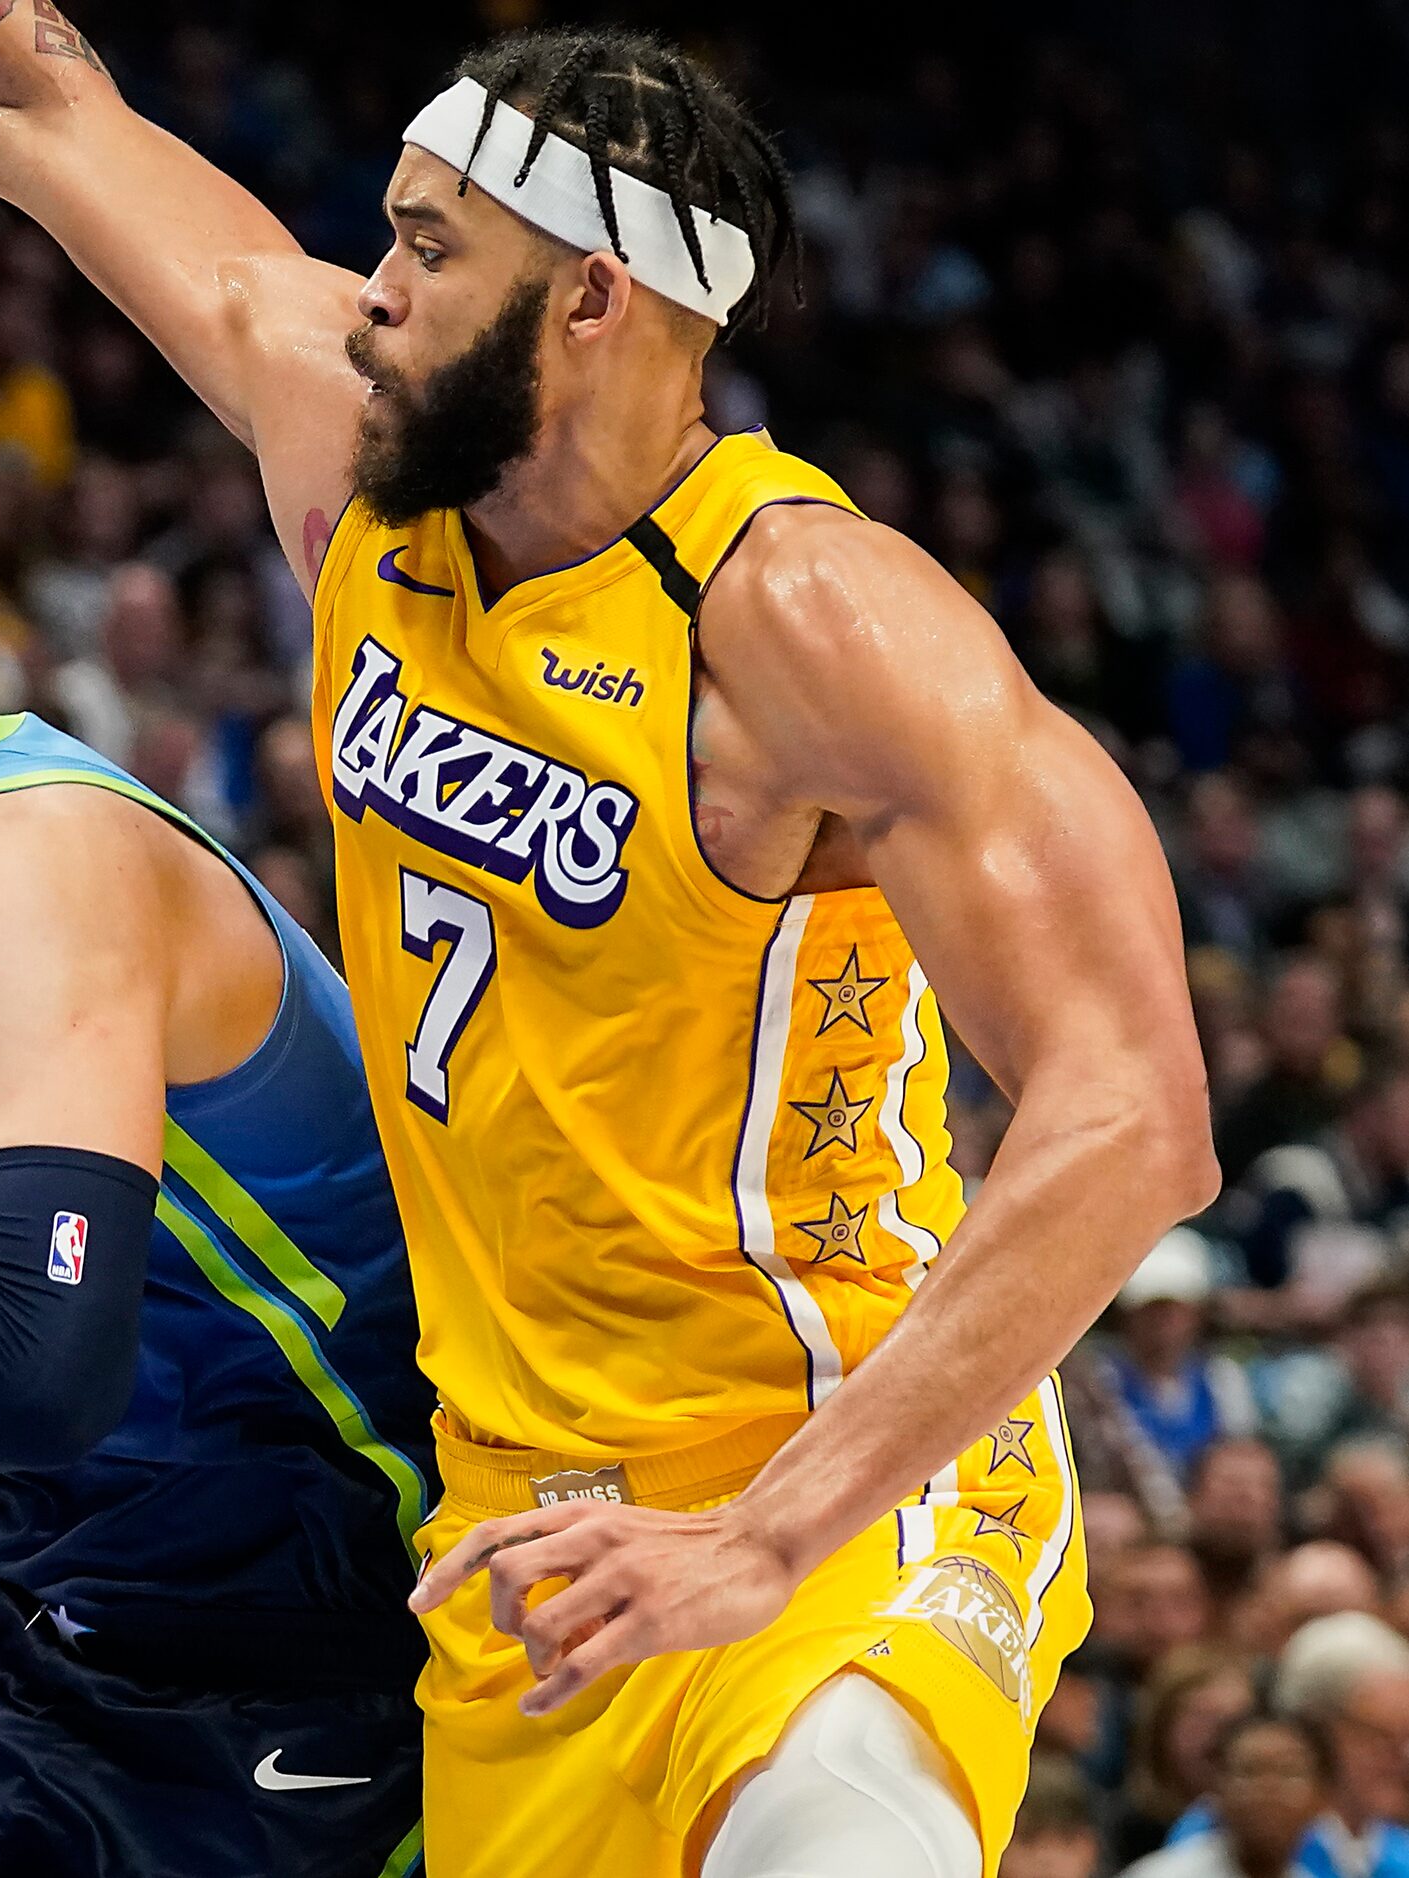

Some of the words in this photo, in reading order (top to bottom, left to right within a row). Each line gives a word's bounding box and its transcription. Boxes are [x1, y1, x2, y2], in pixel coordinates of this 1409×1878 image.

[541, 646, 644, 706] wish
[333, 634, 638, 928] LAKERS
[399, 864, 497, 1127] 7
[52, 1264, 72, 1280] NBA
[956, 1577, 994, 1604] LOS
